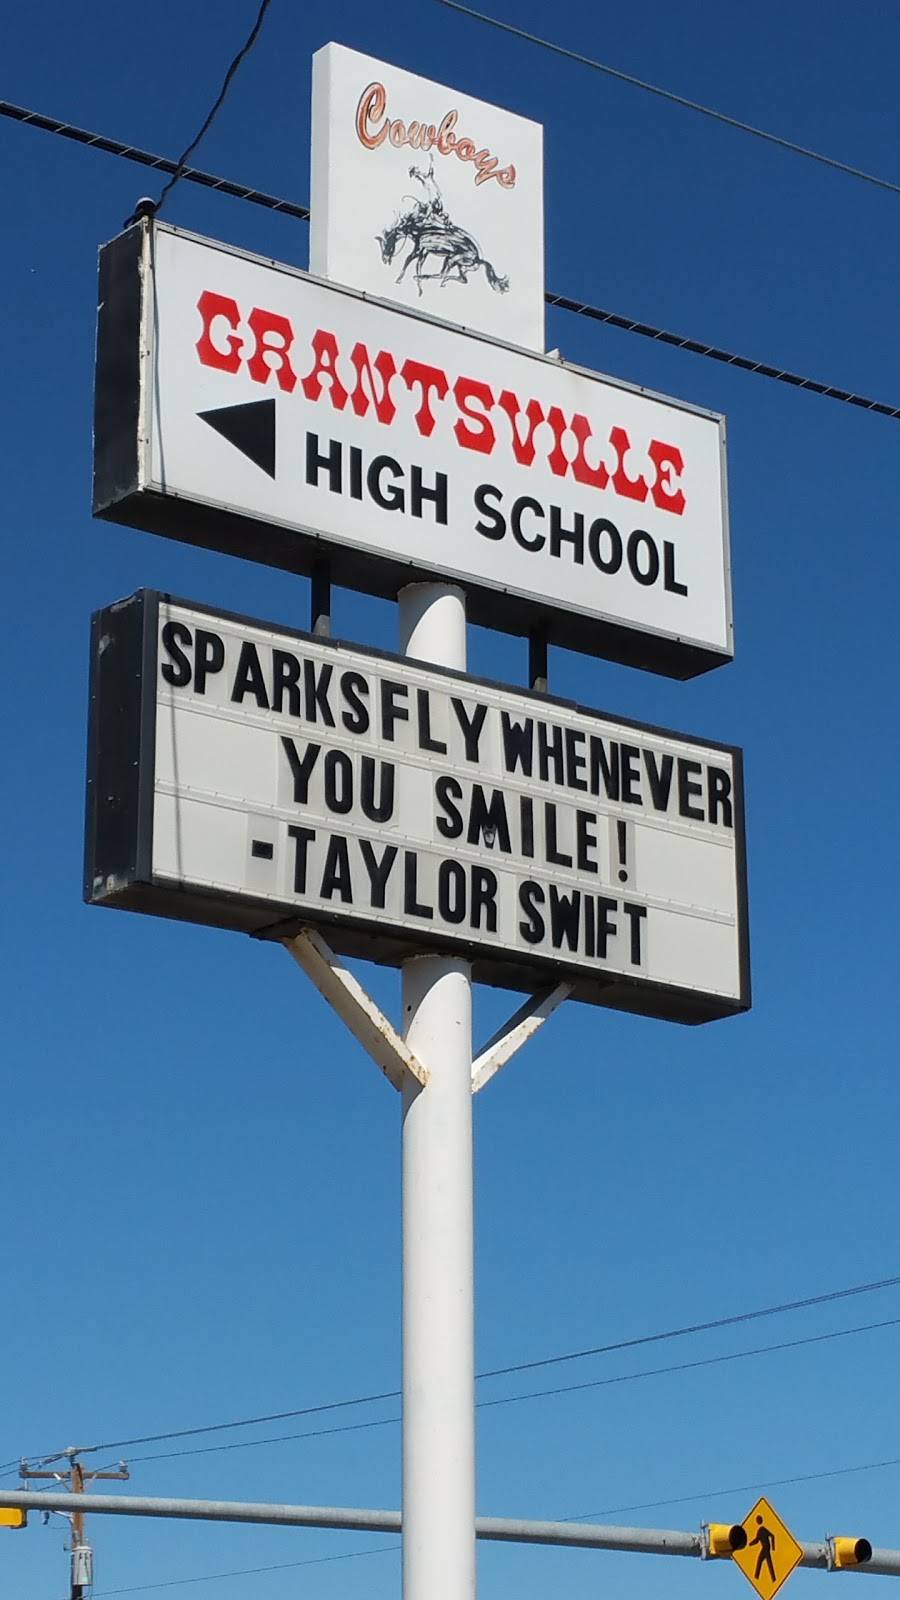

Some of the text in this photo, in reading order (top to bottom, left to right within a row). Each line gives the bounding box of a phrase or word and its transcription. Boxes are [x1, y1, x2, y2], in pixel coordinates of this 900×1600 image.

[356, 82, 516, 189] Cowboys
[196, 290, 687, 516] GRANTSVILLE
[305, 431, 689, 597] HIGH SCHOOL
[161, 620, 734, 828] SPARKS FLY WHENEVER
[281, 736, 629, 882] YOU SMILE!
[519, 879, 648, 966] SWIFT
